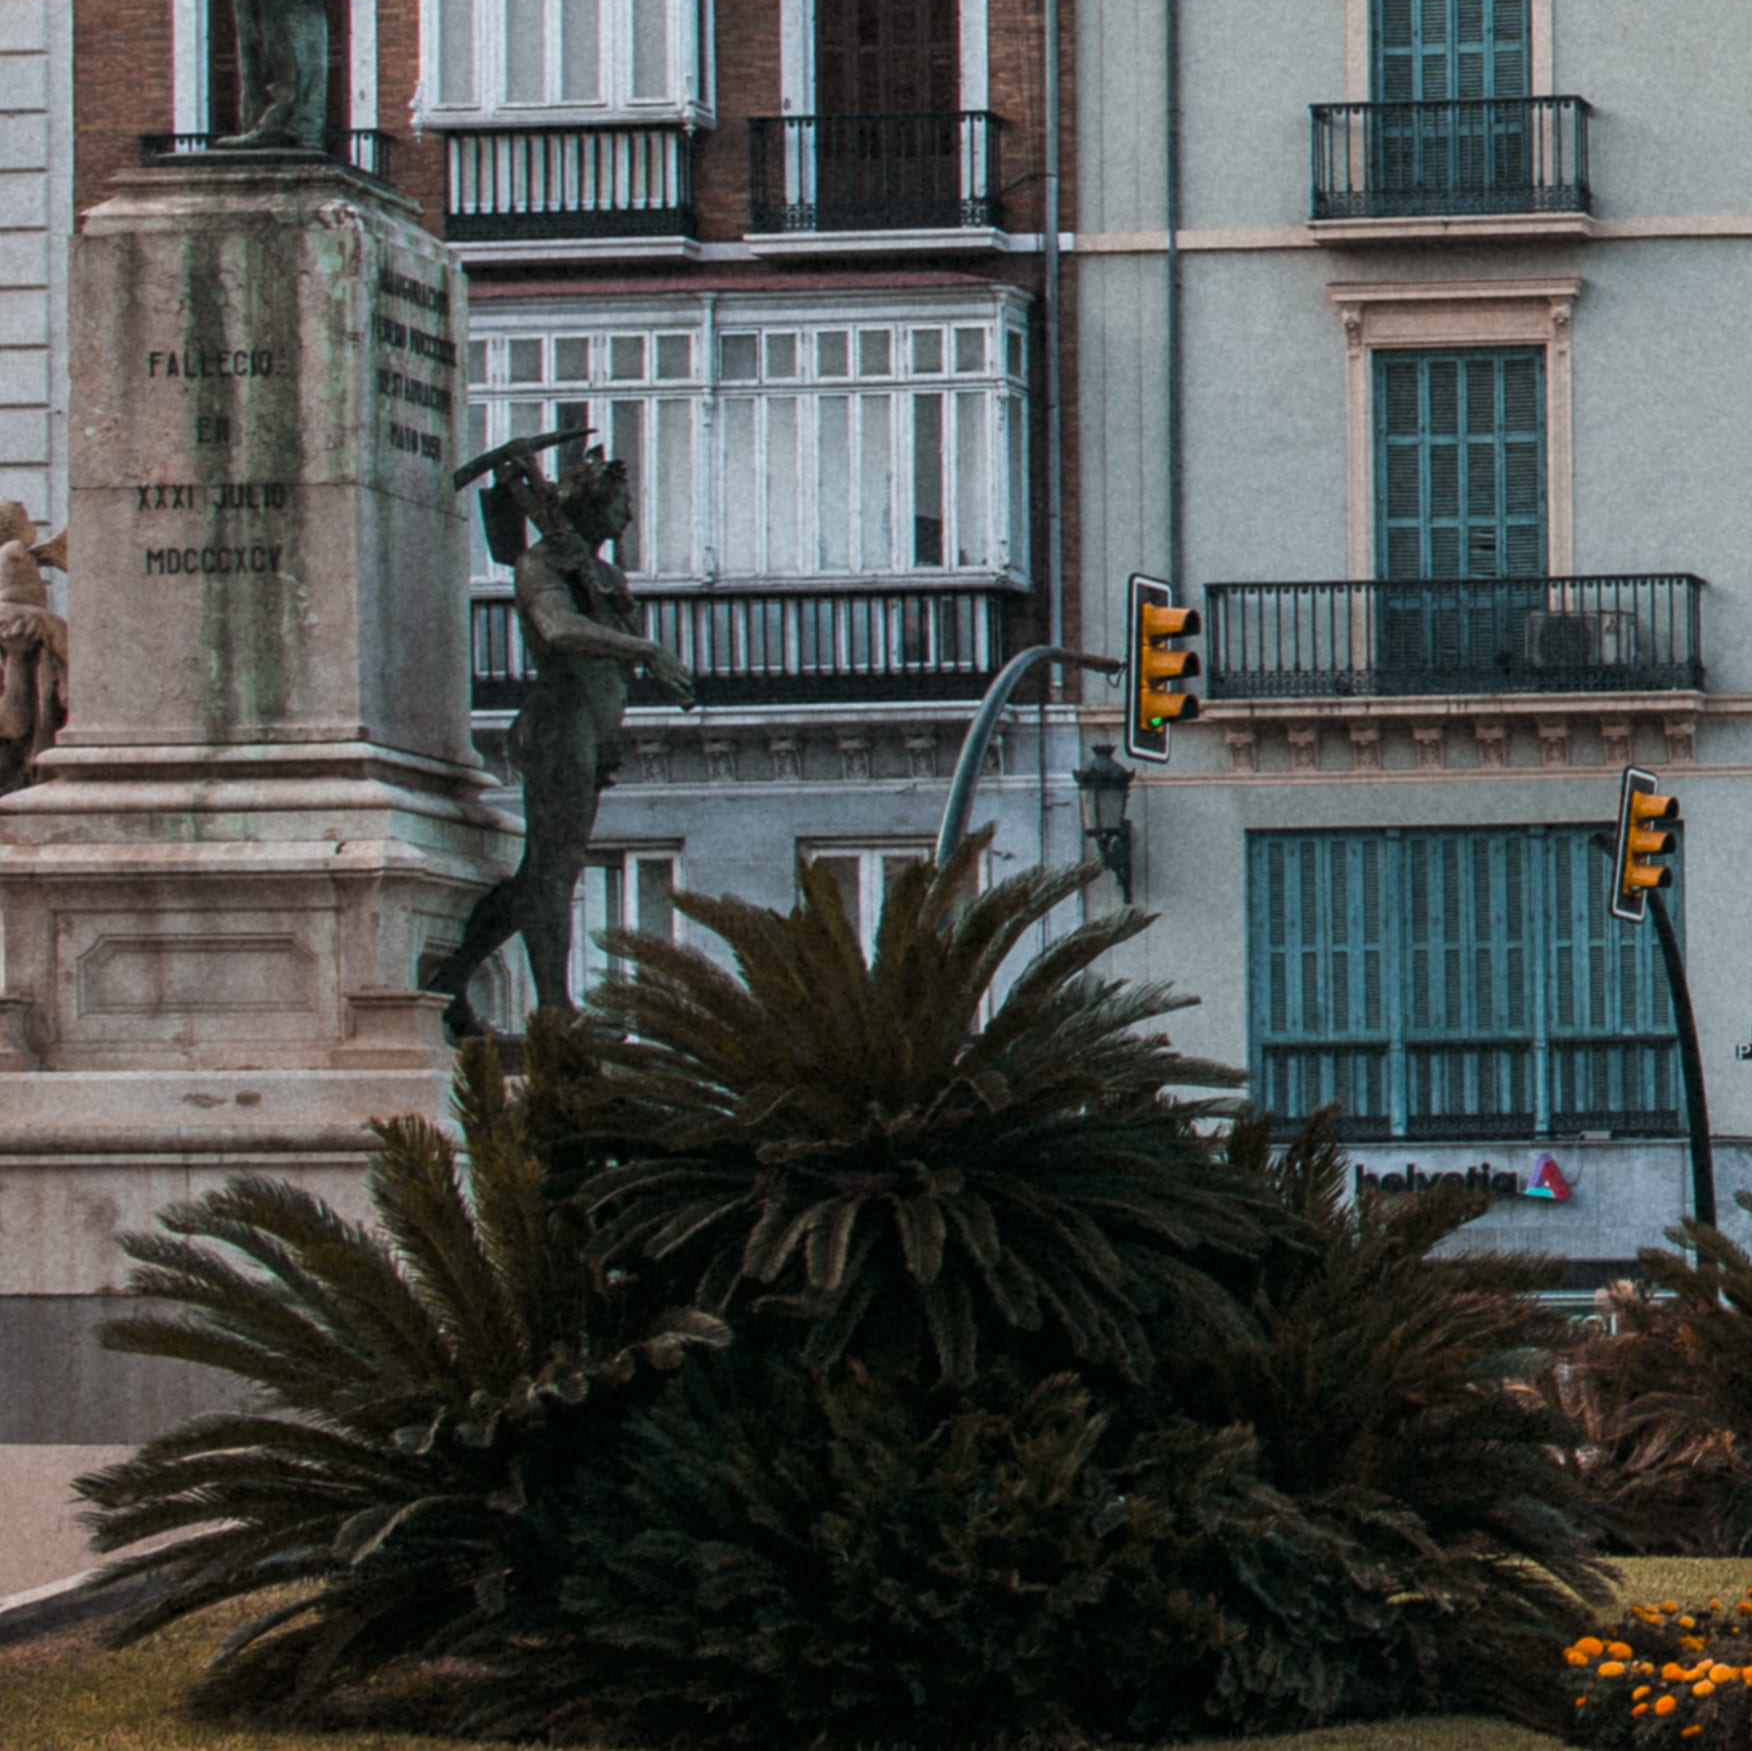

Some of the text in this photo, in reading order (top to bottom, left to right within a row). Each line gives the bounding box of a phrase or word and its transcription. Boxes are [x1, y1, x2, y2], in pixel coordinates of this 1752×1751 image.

[148, 351, 273, 378] FALLECIO
[197, 416, 231, 444] EN
[138, 483, 285, 510] XXXI JULIO
